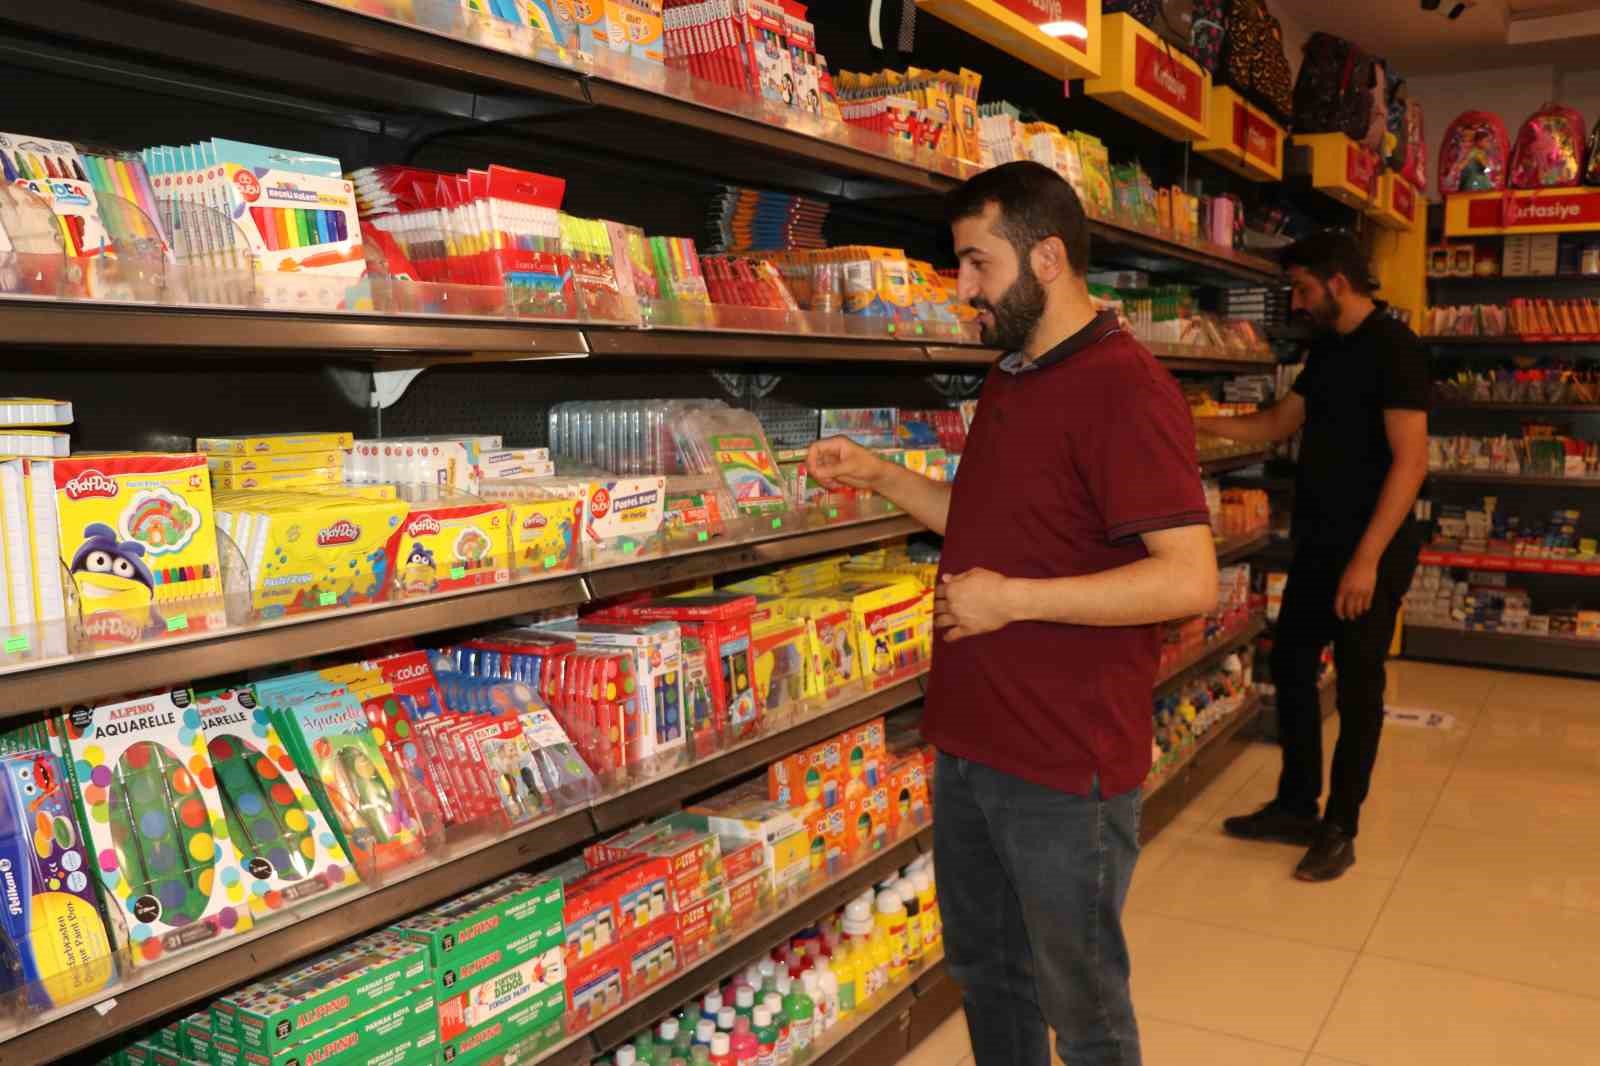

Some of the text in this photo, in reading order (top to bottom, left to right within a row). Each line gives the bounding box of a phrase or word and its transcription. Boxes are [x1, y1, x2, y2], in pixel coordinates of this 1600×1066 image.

[66, 476, 117, 497] Play-Doh
[110, 703, 154, 720] ALPINO
[95, 712, 176, 740] AQUARELLE
[5, 871, 23, 916] Pelikan
[66, 900, 77, 921] Box
[70, 921, 84, 947] Paint
[296, 996, 350, 1030] ALPINO
